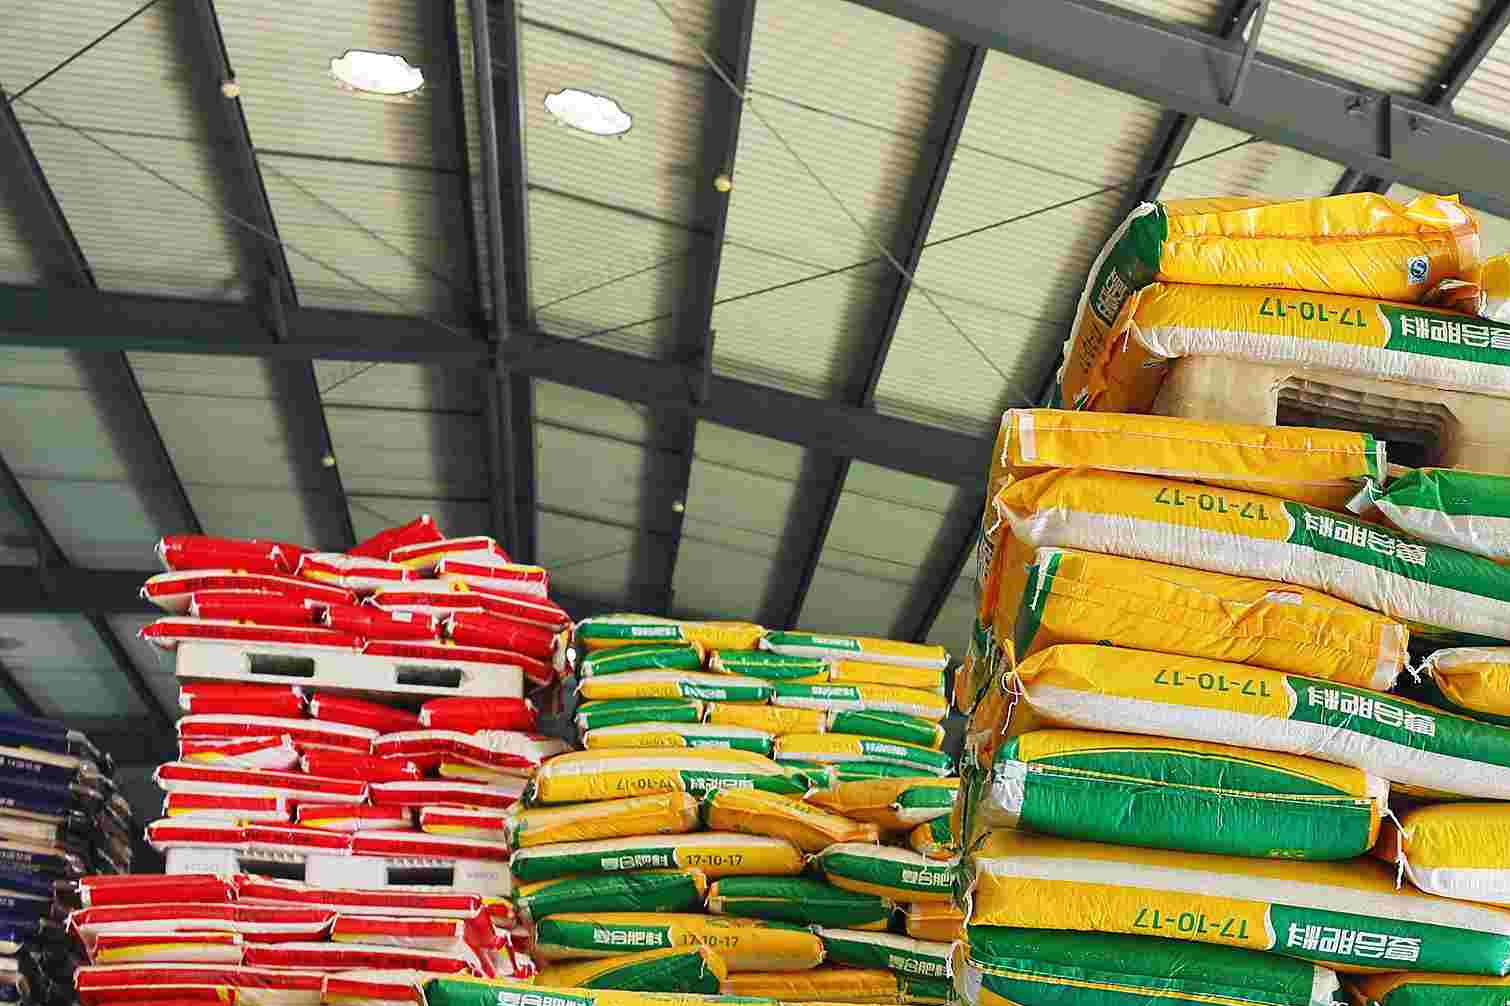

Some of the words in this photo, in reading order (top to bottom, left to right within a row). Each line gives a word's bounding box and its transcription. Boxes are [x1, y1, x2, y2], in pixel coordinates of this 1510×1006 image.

[1258, 296, 1368, 328] 17-10-17
[1153, 487, 1271, 521] 17-10-17
[1303, 511, 1426, 566] 复合肥料
[1153, 669, 1271, 698] 17-10-17
[1307, 686, 1435, 737] 复合肥料
[687, 854, 743, 869] 17-10-17
[682, 933, 738, 948] 17-10-17
[1133, 906, 1249, 942] 17-10-17
[1287, 921, 1422, 963] 复合肥料
